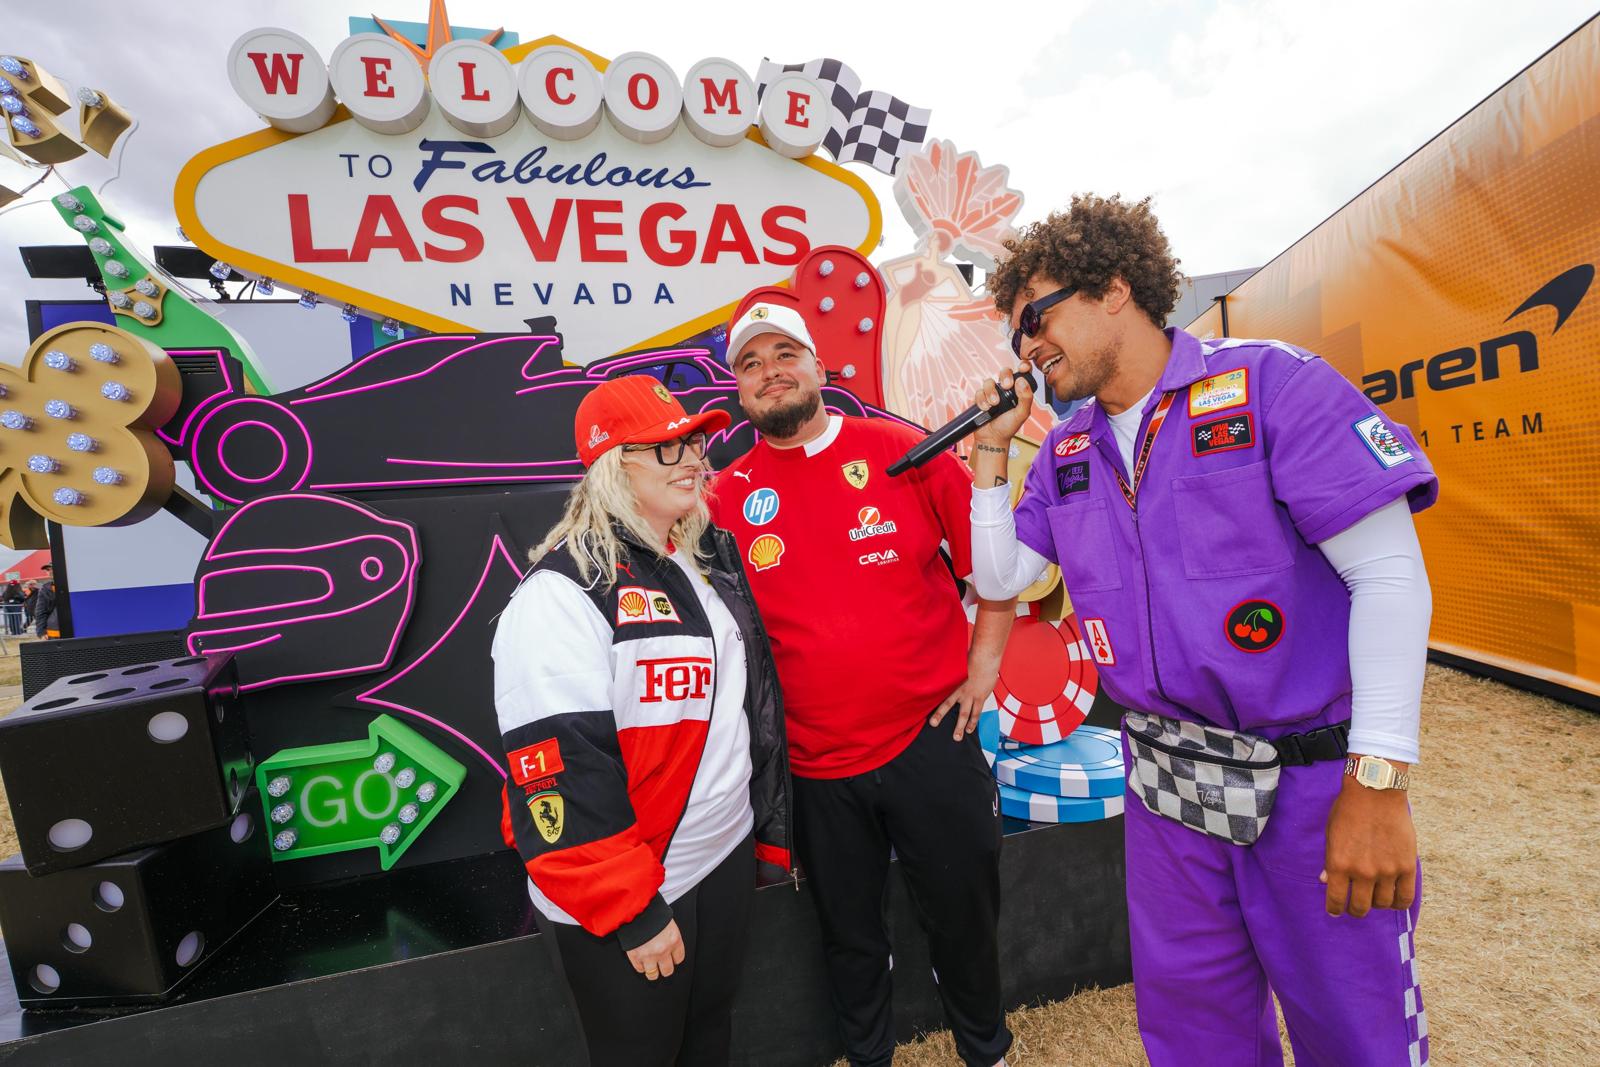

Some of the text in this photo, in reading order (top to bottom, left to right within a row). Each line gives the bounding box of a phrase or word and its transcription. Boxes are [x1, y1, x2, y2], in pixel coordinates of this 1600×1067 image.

[247, 53, 810, 129] WELCOME
[339, 139, 711, 192] TO Fabulous
[287, 194, 811, 265] LAS VEGAS
[450, 283, 675, 306] NEVADA
[1208, 435, 1236, 447] VEGAS
[1212, 430, 1229, 439] LAS
[1451, 413, 1543, 443] TEAM
[750, 488, 774, 524] hp
[850, 521, 896, 541] UniCredit
[520, 751, 546, 778] F-1
[300, 769, 399, 828] GO
